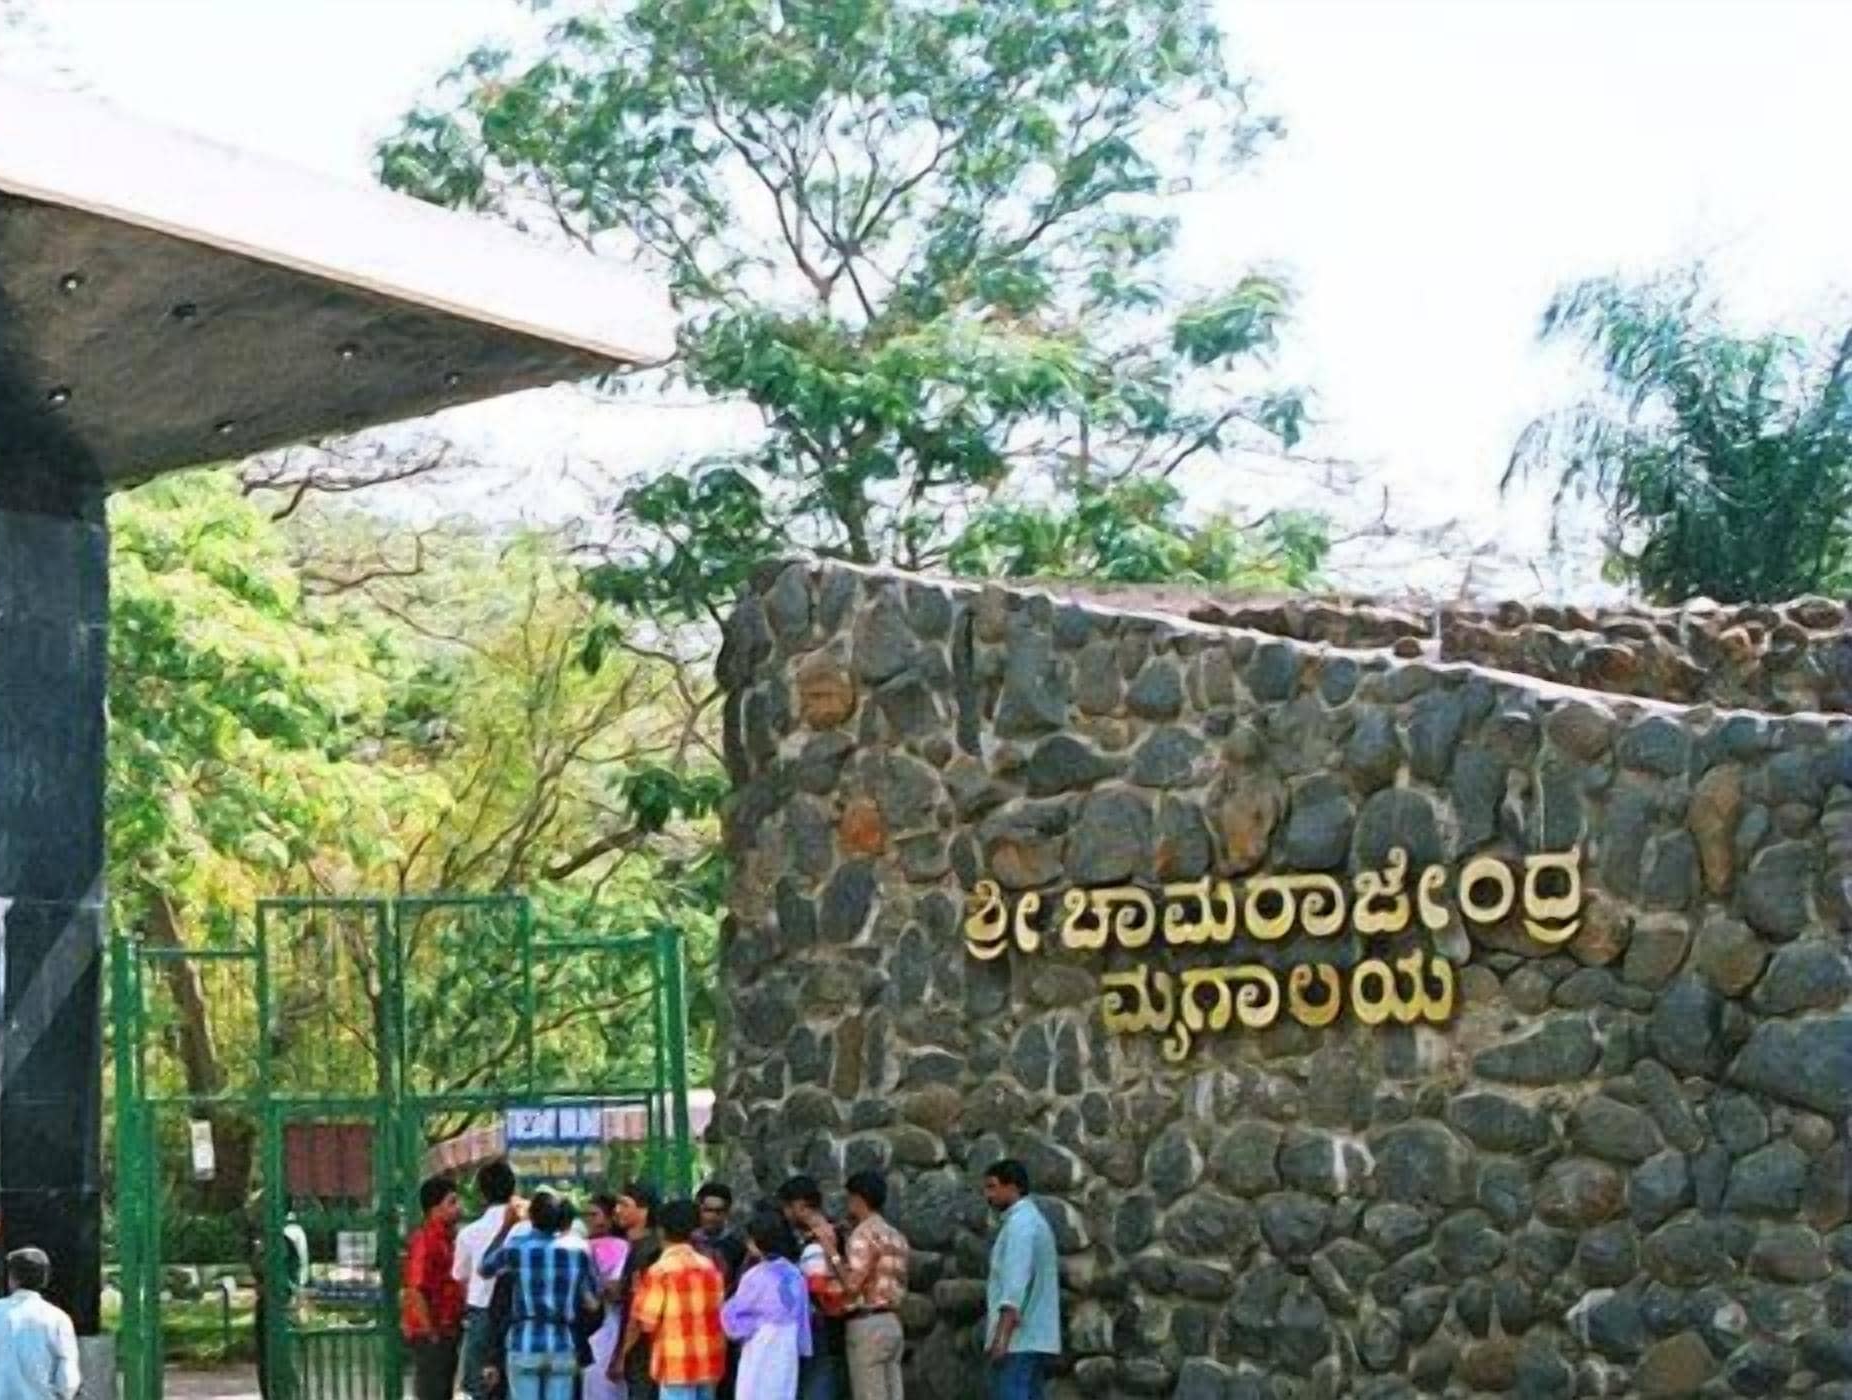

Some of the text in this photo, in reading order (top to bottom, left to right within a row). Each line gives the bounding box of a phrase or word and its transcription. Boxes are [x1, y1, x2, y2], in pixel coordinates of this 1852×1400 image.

[964, 845, 1582, 960] ಶ್ರೀ ಚಾಮರಾಜೇಂದ್ರ
[1100, 948, 1454, 1059] ಮೃಗಾಲಯ
